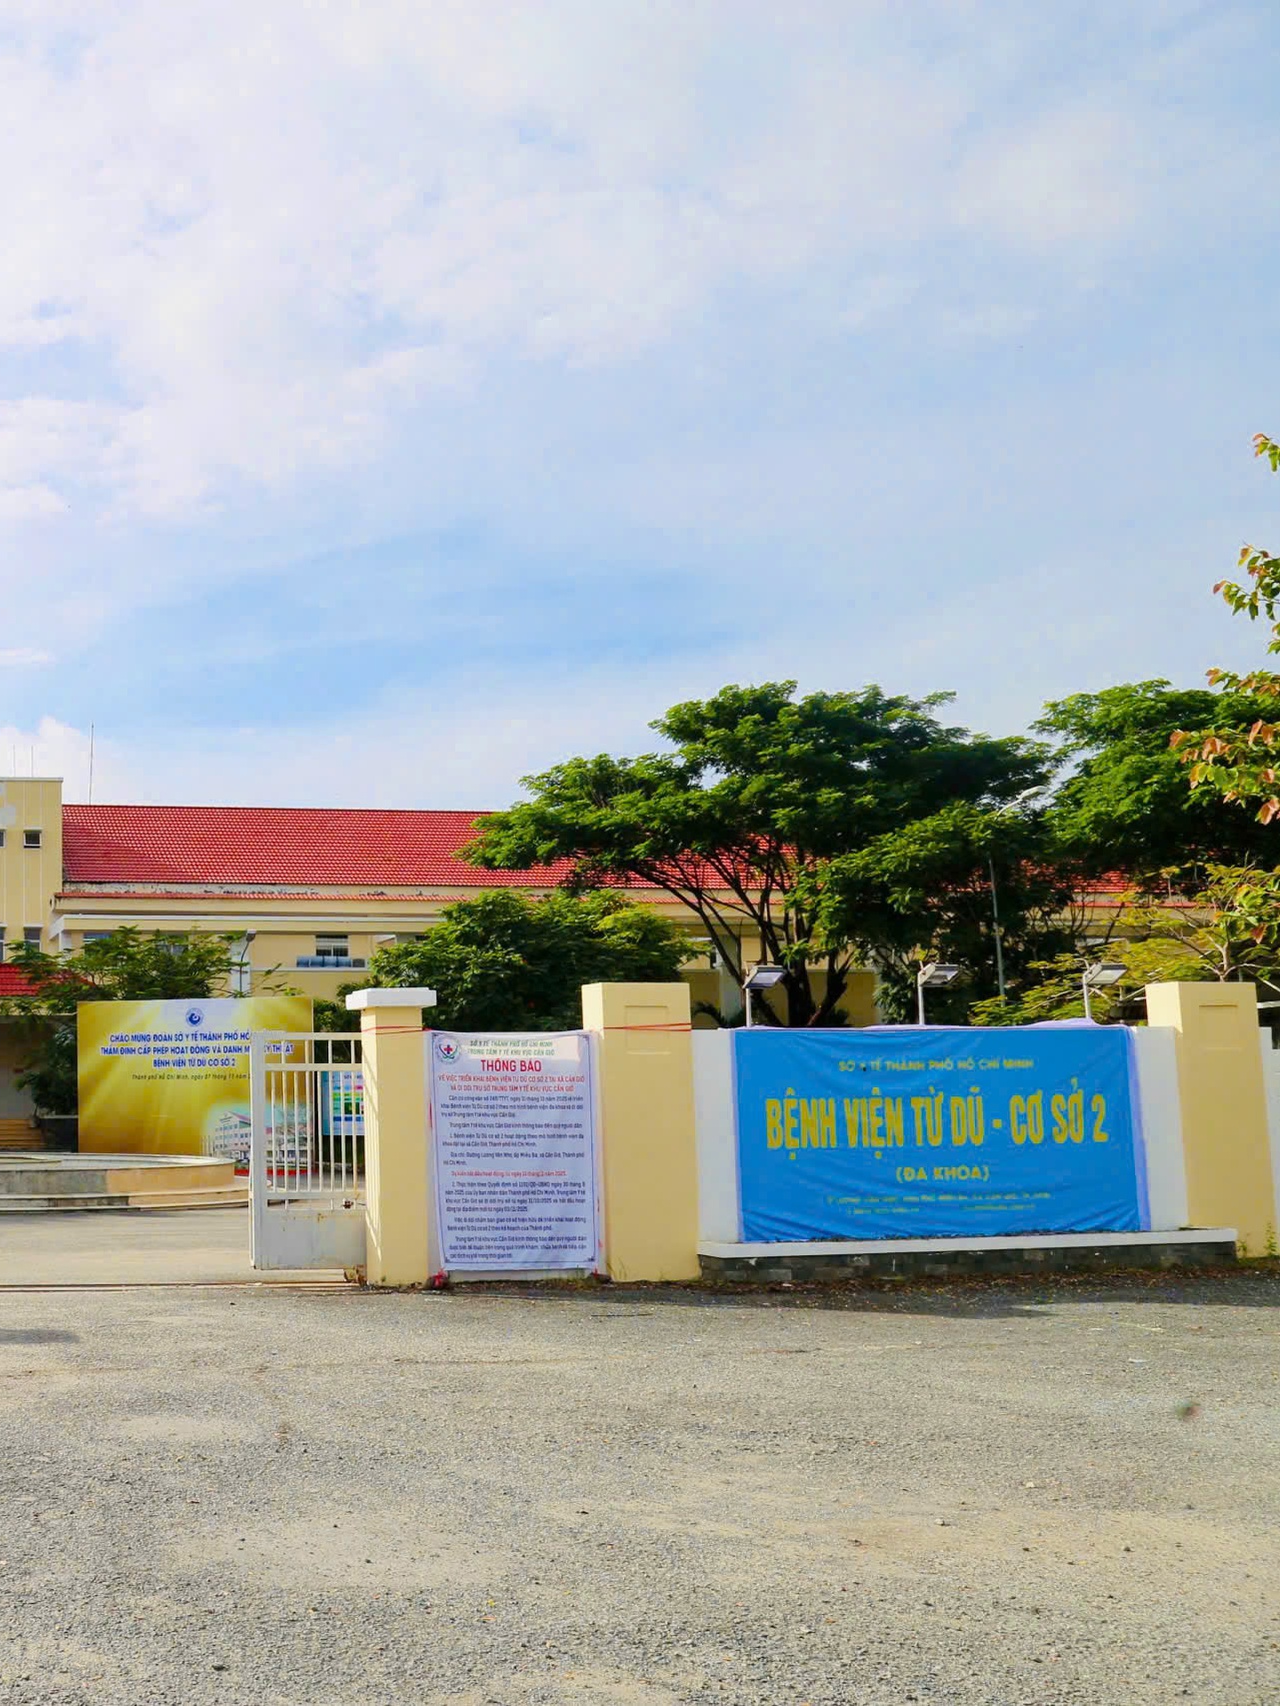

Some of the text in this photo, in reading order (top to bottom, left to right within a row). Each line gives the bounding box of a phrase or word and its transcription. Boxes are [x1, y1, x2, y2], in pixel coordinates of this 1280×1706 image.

[232, 1058, 236, 1066] 2
[480, 1058, 542, 1072] THÔNG BÁO
[766, 1087, 837, 1160] BỆNH
[844, 1086, 904, 1160] VIỆN
[910, 1086, 944, 1146] TỪ
[950, 1086, 985, 1146] DŨ
[1010, 1089, 1044, 1145] CƠ
[1051, 1077, 1084, 1144] SỞ
[1091, 1094, 1109, 1142] 2
[896, 1165, 990, 1183] (ĐA KHOA)
